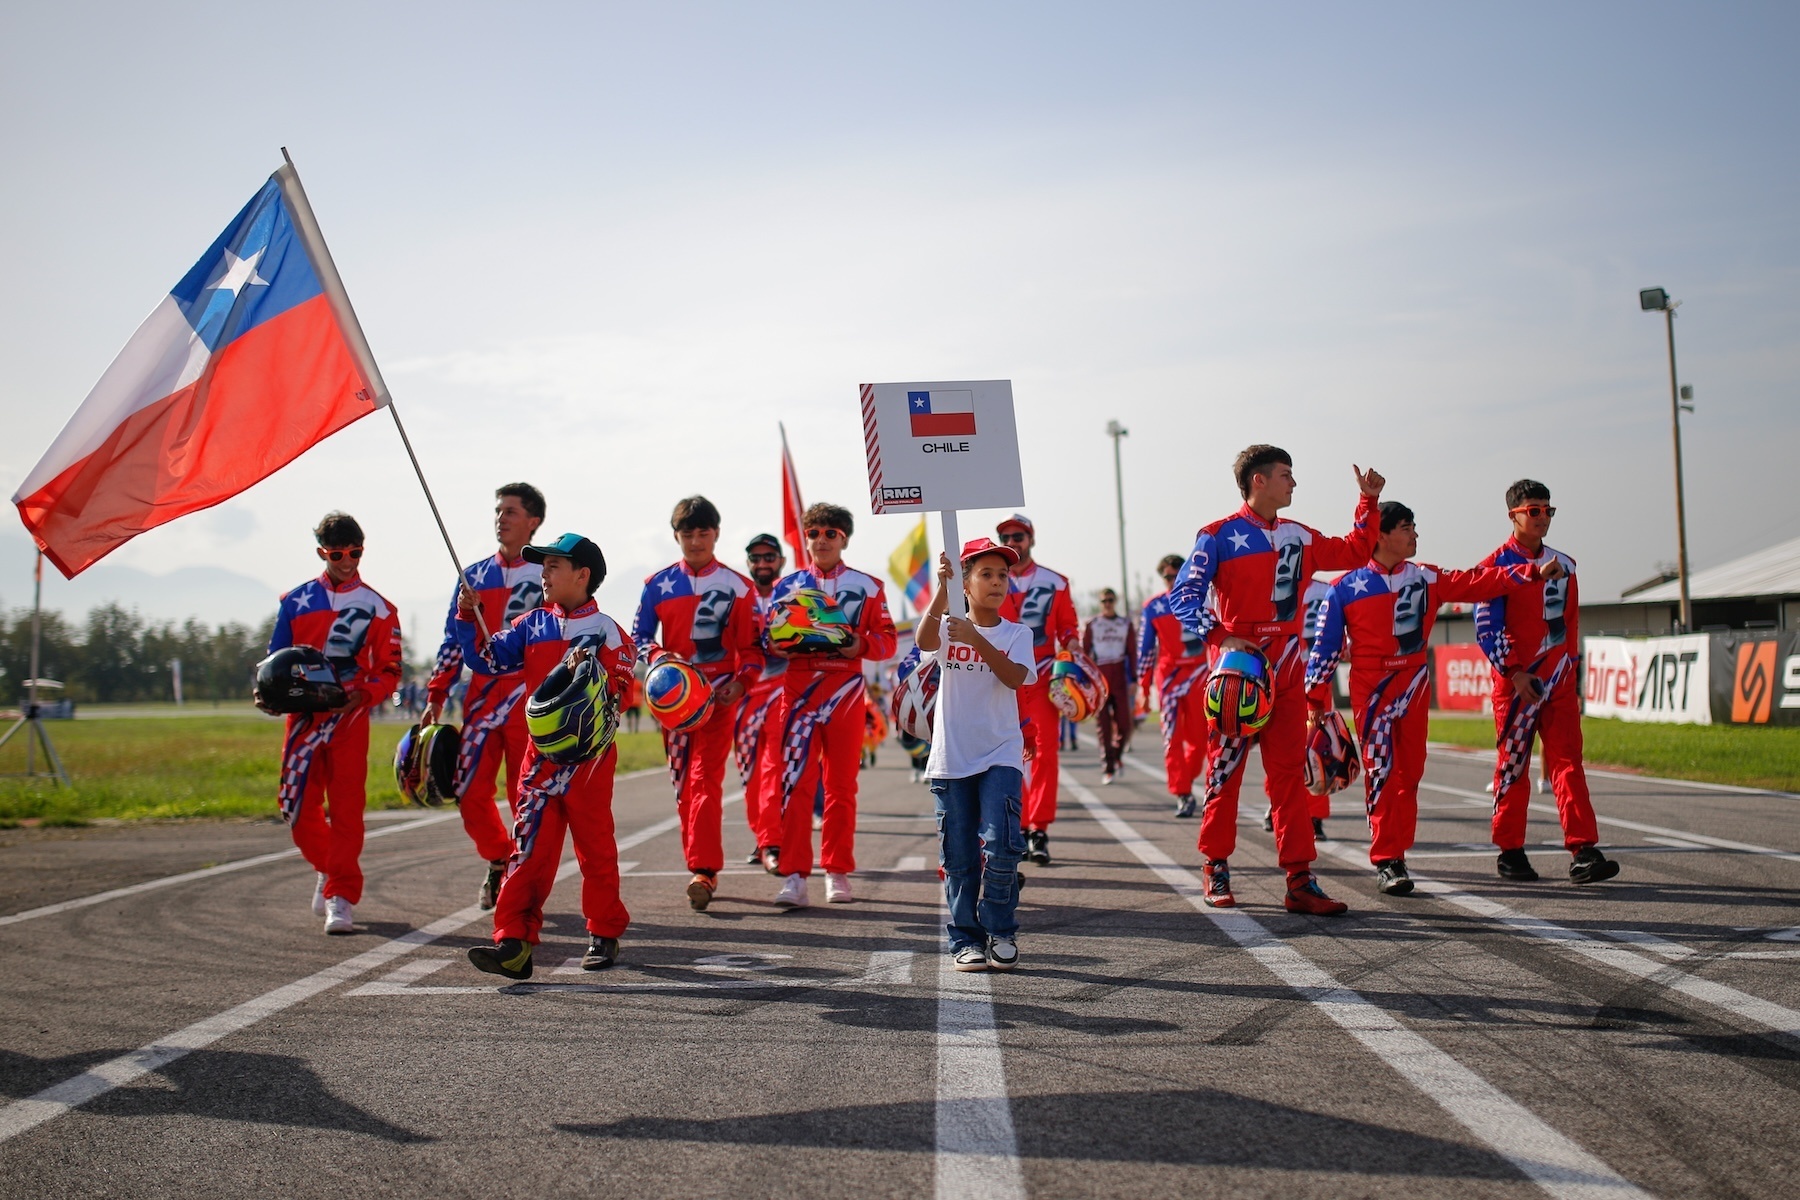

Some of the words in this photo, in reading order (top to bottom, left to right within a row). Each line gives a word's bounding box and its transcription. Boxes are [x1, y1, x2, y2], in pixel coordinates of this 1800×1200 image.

[922, 442, 970, 454] CHILE
[883, 487, 921, 500] RMC
[1448, 678, 1494, 697] FINA
